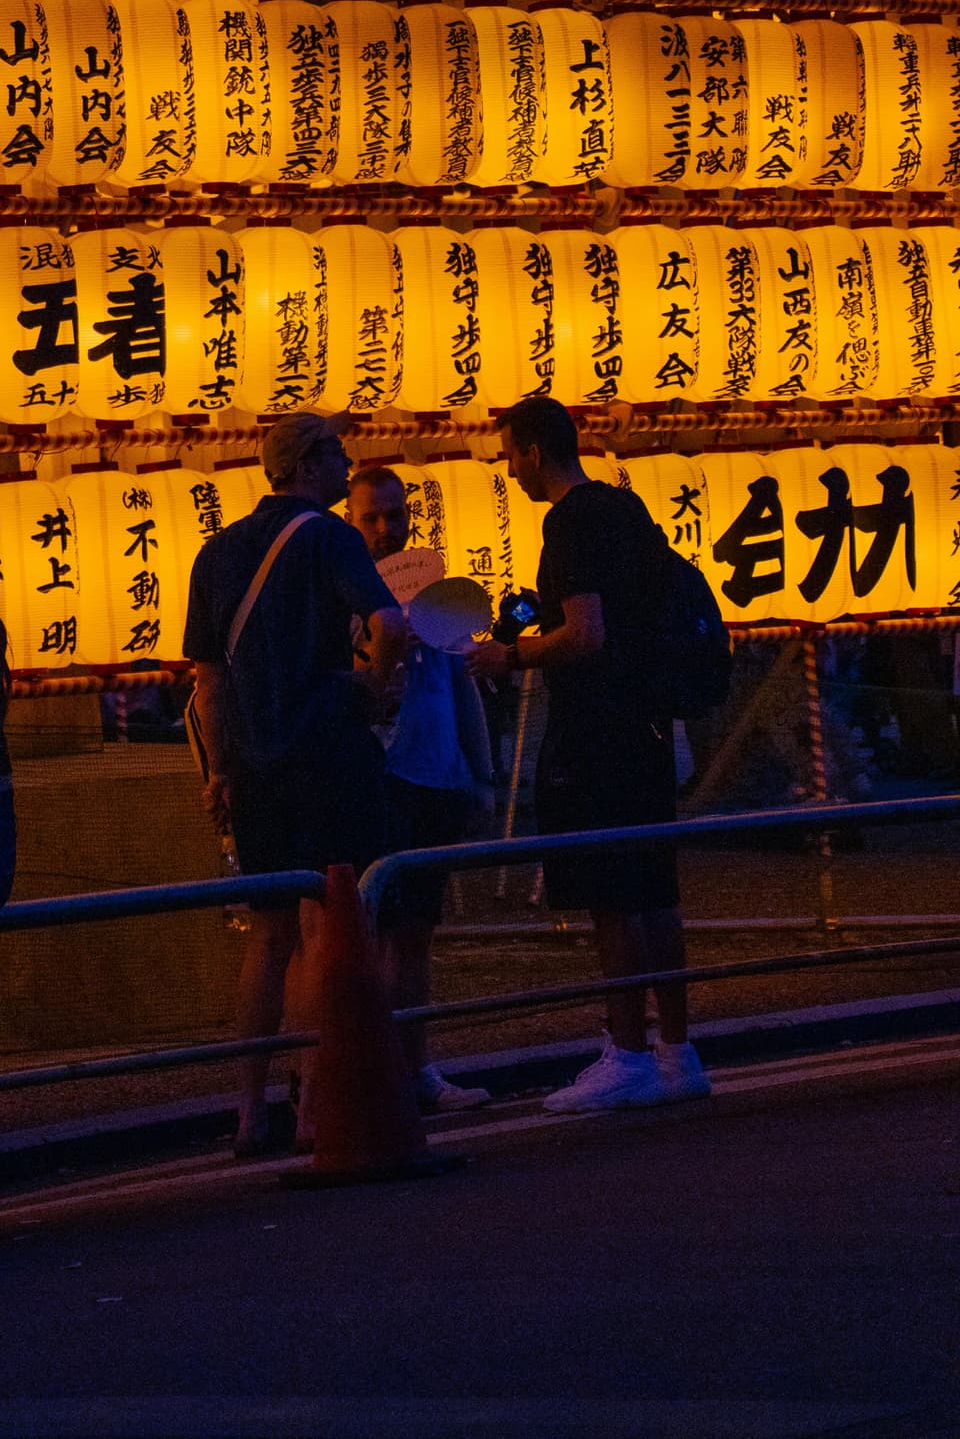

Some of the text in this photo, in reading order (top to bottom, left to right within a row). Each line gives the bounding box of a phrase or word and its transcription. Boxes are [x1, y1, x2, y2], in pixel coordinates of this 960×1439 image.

[74, 45, 113, 163] 山内会
[136, 90, 183, 182] 戦友会
[218, 10, 258, 159] 機関銃中隊
[754, 94, 796, 181] 戦友会
[809, 110, 858, 187] 戦友会
[188, 248, 243, 410] 山本唯志
[441, 241, 482, 409] 独守歩四会
[582, 243, 623, 402] 独守歩四会
[654, 250, 694, 390] 広友会
[767, 247, 817, 398] 山西友の会
[31, 505, 80, 657] 井上明
